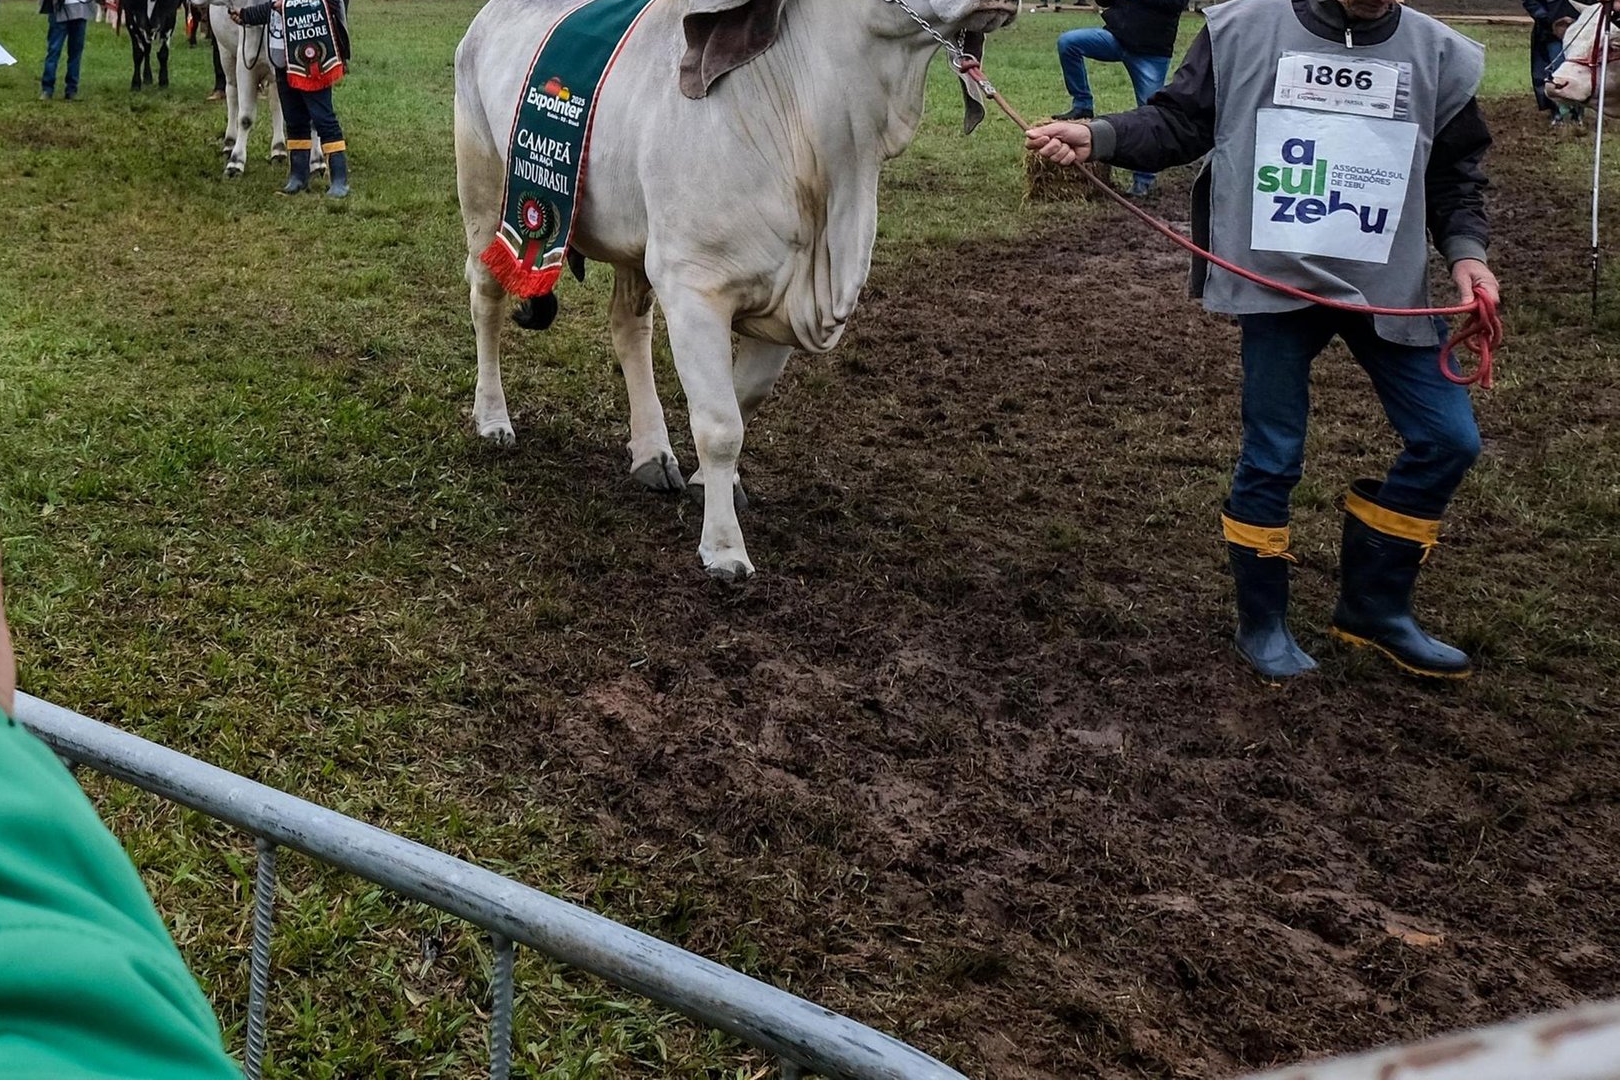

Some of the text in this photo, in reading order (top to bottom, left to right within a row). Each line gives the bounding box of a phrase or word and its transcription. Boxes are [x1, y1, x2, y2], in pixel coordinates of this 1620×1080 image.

[289, 25, 328, 42] NELORE
[1304, 64, 1373, 90] 1866
[571, 95, 585, 106] 2025
[518, 129, 571, 164] CAMPEÃ
[530, 152, 538, 161] DA
[1281, 138, 1316, 166] a
[514, 157, 569, 195] INDUBRASIL
[1257, 159, 1328, 196] sul
[1333, 164, 1404, 180] ASSOCIAÇÃO SUL
[1344, 173, 1391, 186] CRIADORES
[1344, 181, 1365, 190] ZEBU
[1270, 190, 1388, 234] zebu
